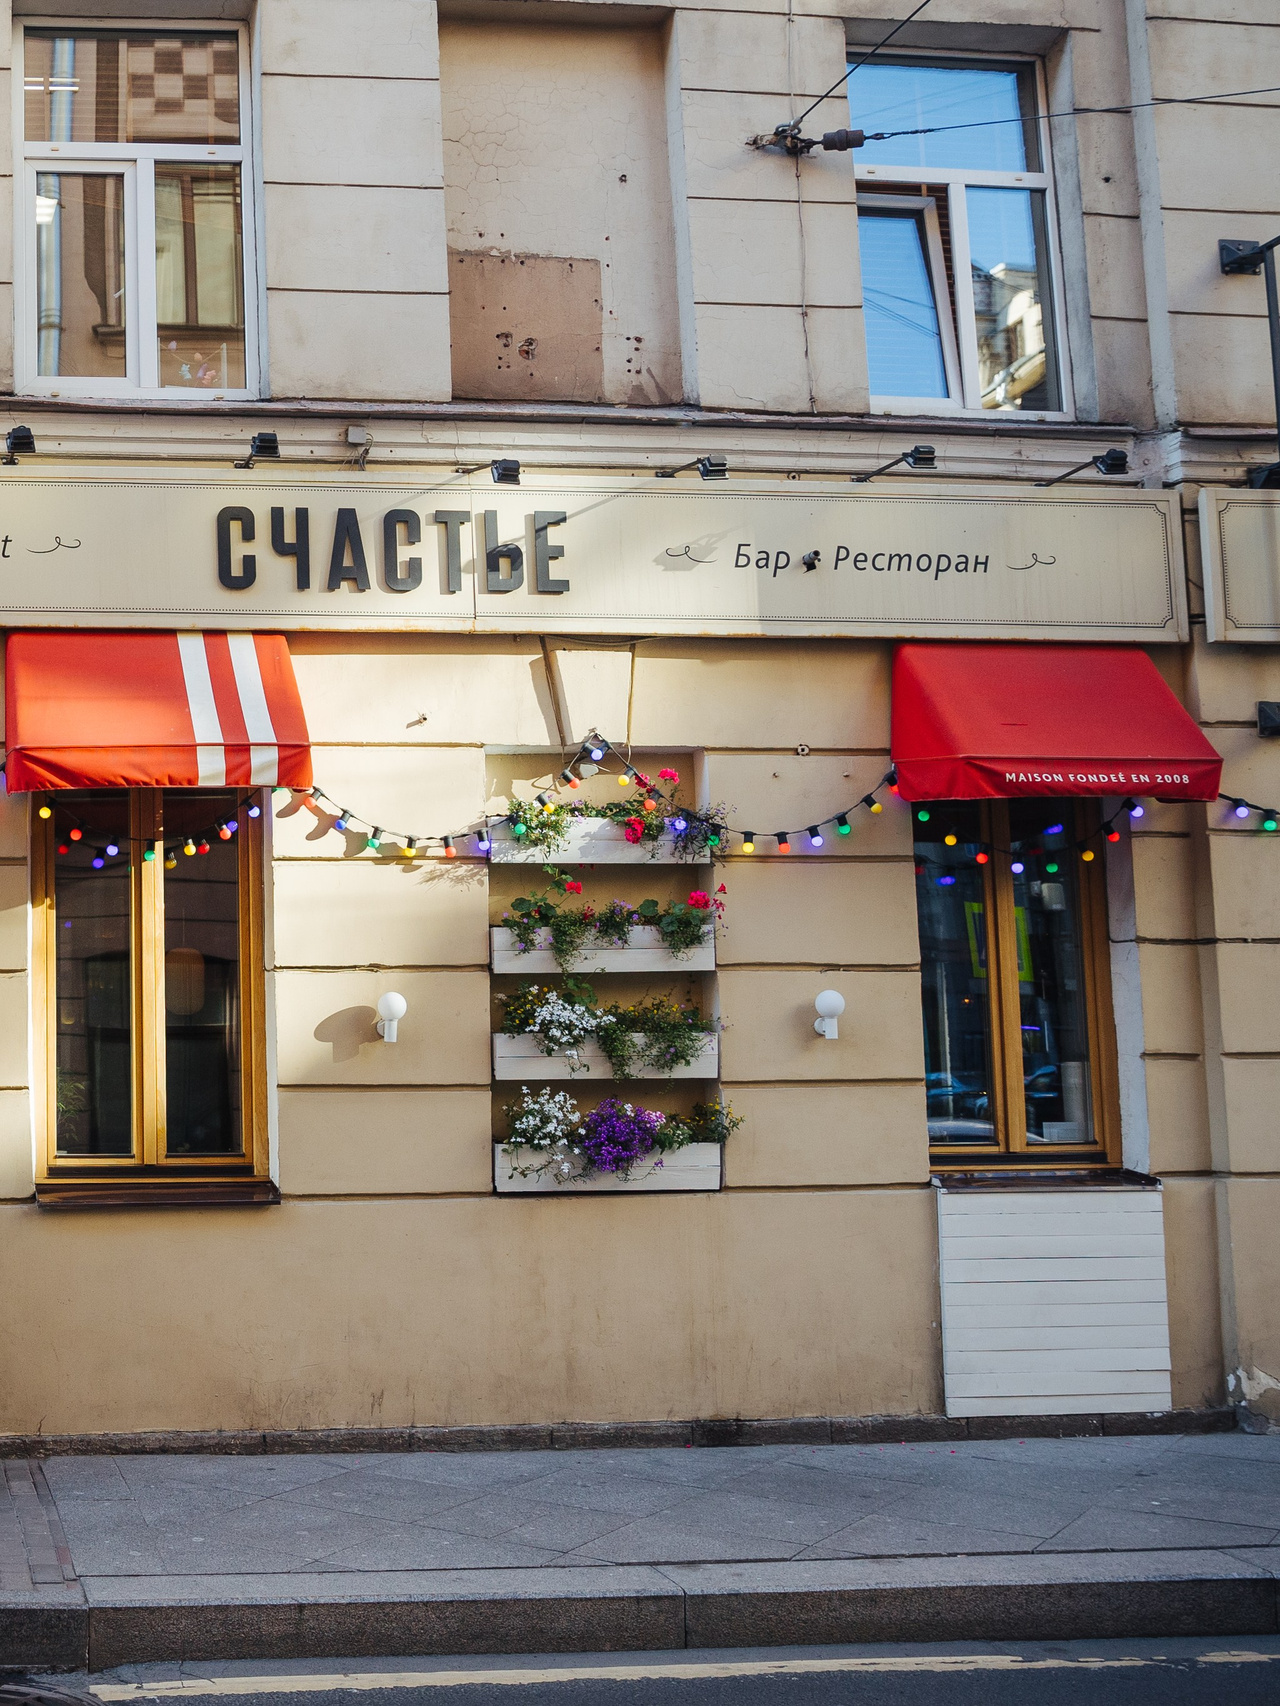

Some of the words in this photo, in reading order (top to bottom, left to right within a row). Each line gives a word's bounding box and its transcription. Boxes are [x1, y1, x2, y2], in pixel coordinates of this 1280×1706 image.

[217, 506, 571, 592] СЧАСТЬЕ
[734, 543, 792, 577] Бар
[833, 545, 990, 581] Ресторан
[1005, 772, 1064, 783] MAISON
[1131, 774, 1151, 783] EN
[1155, 774, 1190, 784] 2008
